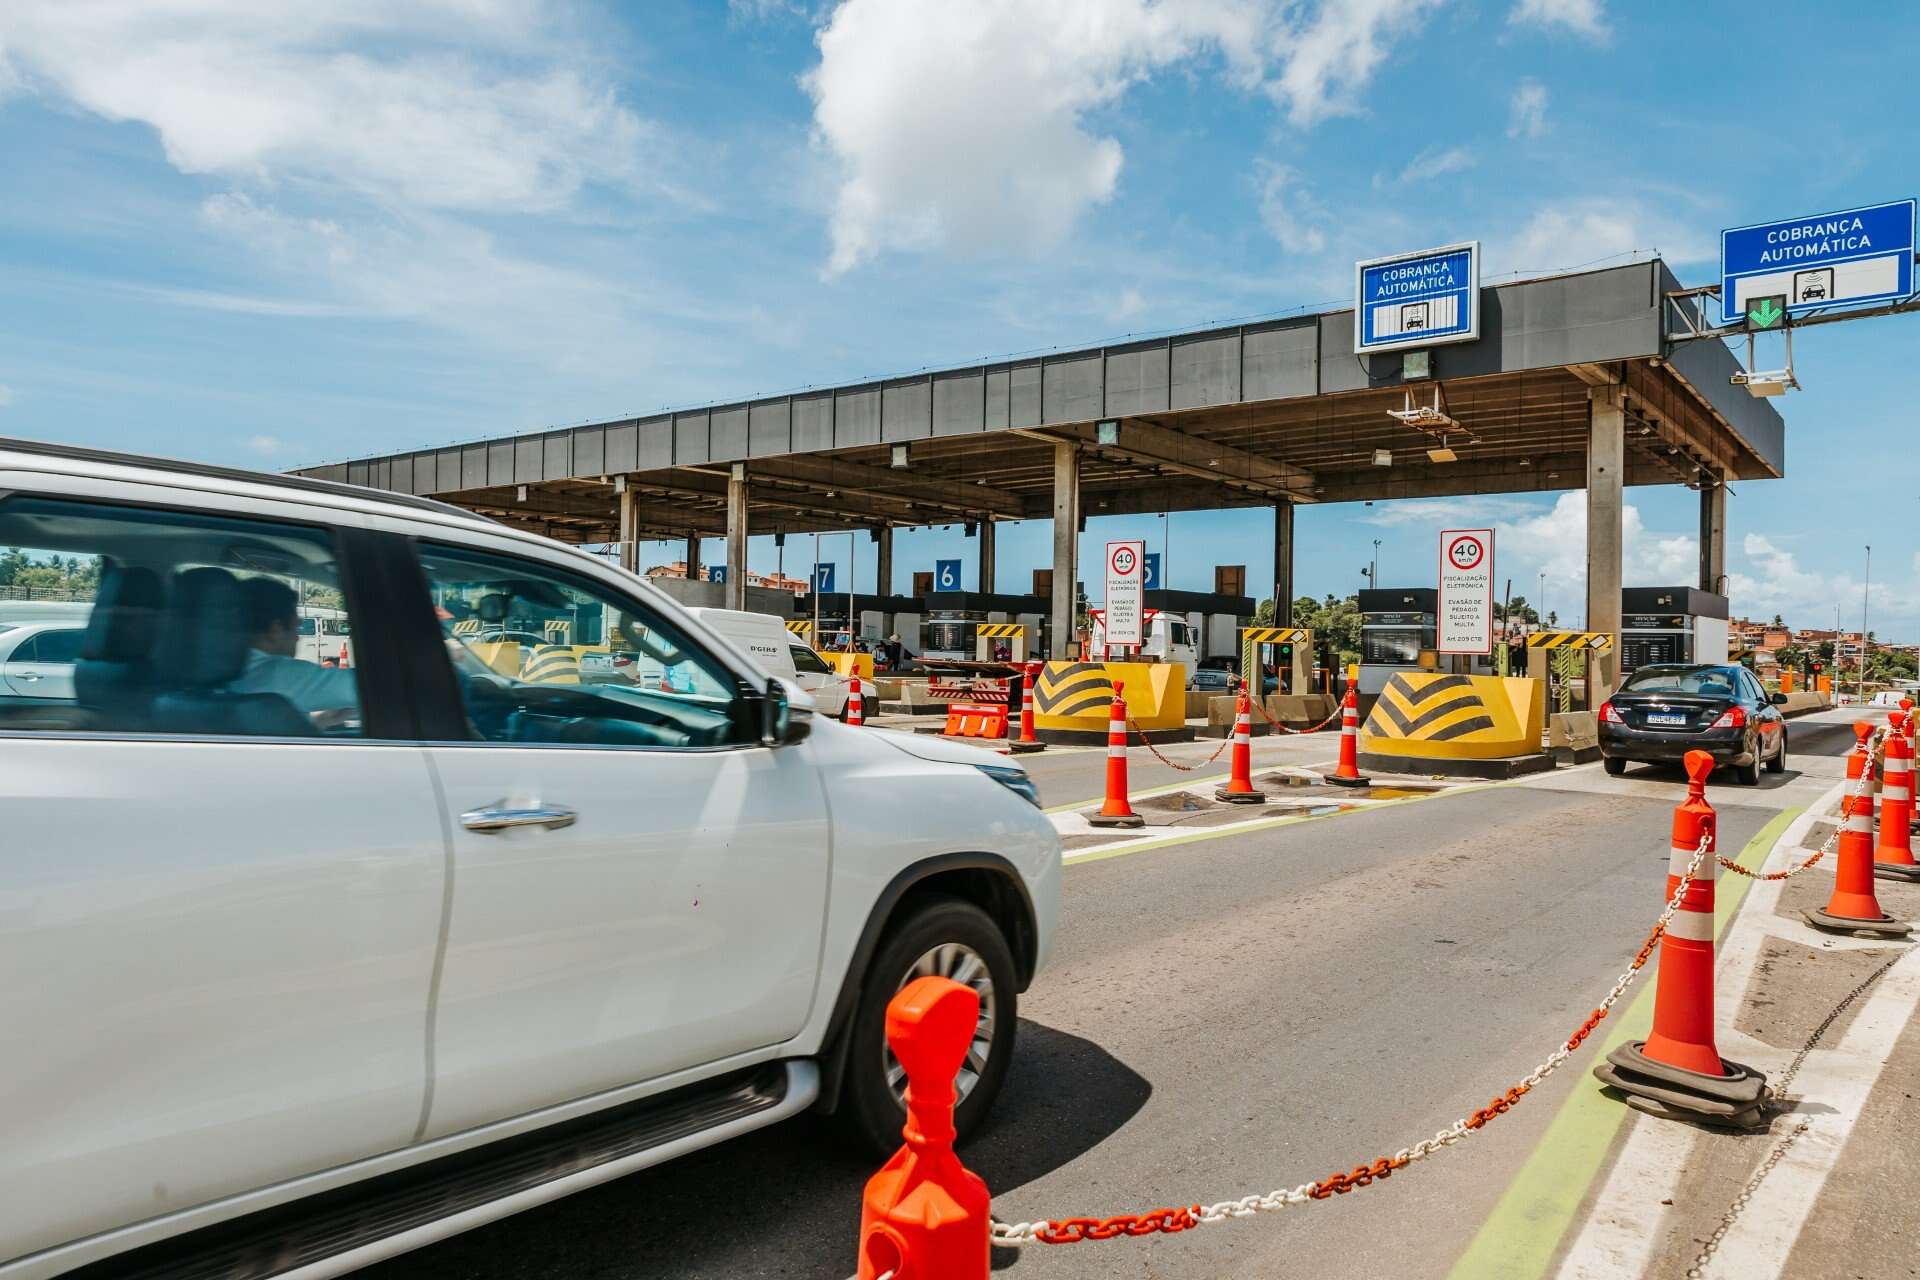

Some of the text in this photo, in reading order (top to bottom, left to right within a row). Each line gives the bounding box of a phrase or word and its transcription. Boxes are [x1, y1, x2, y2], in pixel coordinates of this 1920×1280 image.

[1767, 218, 1863, 244] COBRANÇA
[1760, 235, 1871, 263] AUTOMÁTICA
[1382, 261, 1450, 281] COBRANÇA
[1377, 274, 1455, 296] AUTOMÁTICA
[1116, 553, 1132, 563] 40
[1454, 544, 1478, 556] 40
[819, 568, 830, 588] 7
[941, 565, 954, 587] 6
